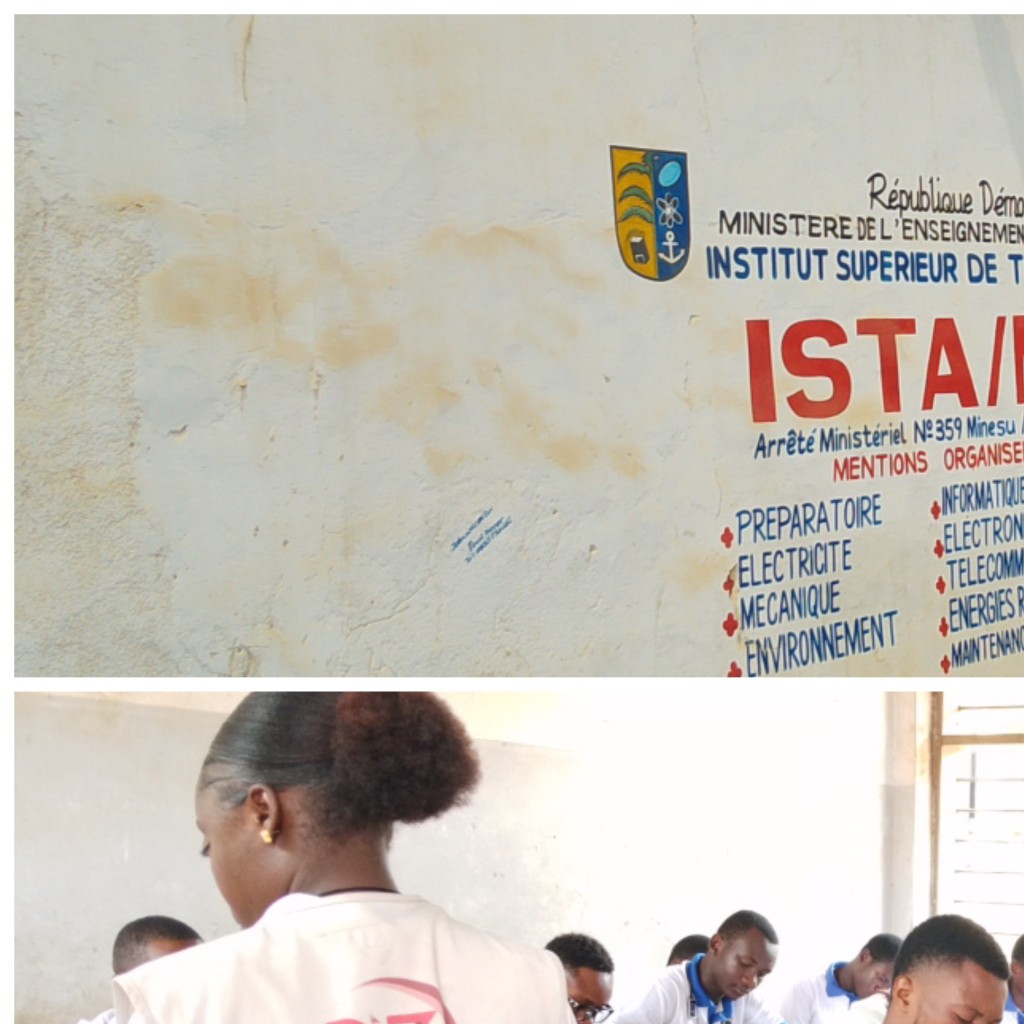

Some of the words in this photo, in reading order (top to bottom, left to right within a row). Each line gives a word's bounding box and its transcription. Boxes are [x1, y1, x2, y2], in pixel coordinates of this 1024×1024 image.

[867, 172, 973, 217] République
[719, 210, 853, 239] MINISTERE
[857, 217, 876, 241] DE
[706, 246, 828, 280] INSTITUT
[836, 249, 958, 283] SUPERIEUR
[967, 252, 997, 284] DE
[754, 427, 816, 459] Arrêté
[819, 425, 907, 452] Ministériel
[967, 415, 1016, 438] Minesu
[833, 450, 928, 482] MENTIONS
[736, 494, 882, 545] PREPARATOIRE
[738, 539, 852, 588] ELECTRICITE
[740, 580, 840, 630] MECANIQUE
[949, 588, 1015, 633] ENERGIES
[744, 610, 898, 678] ENVIRONNEMENT
